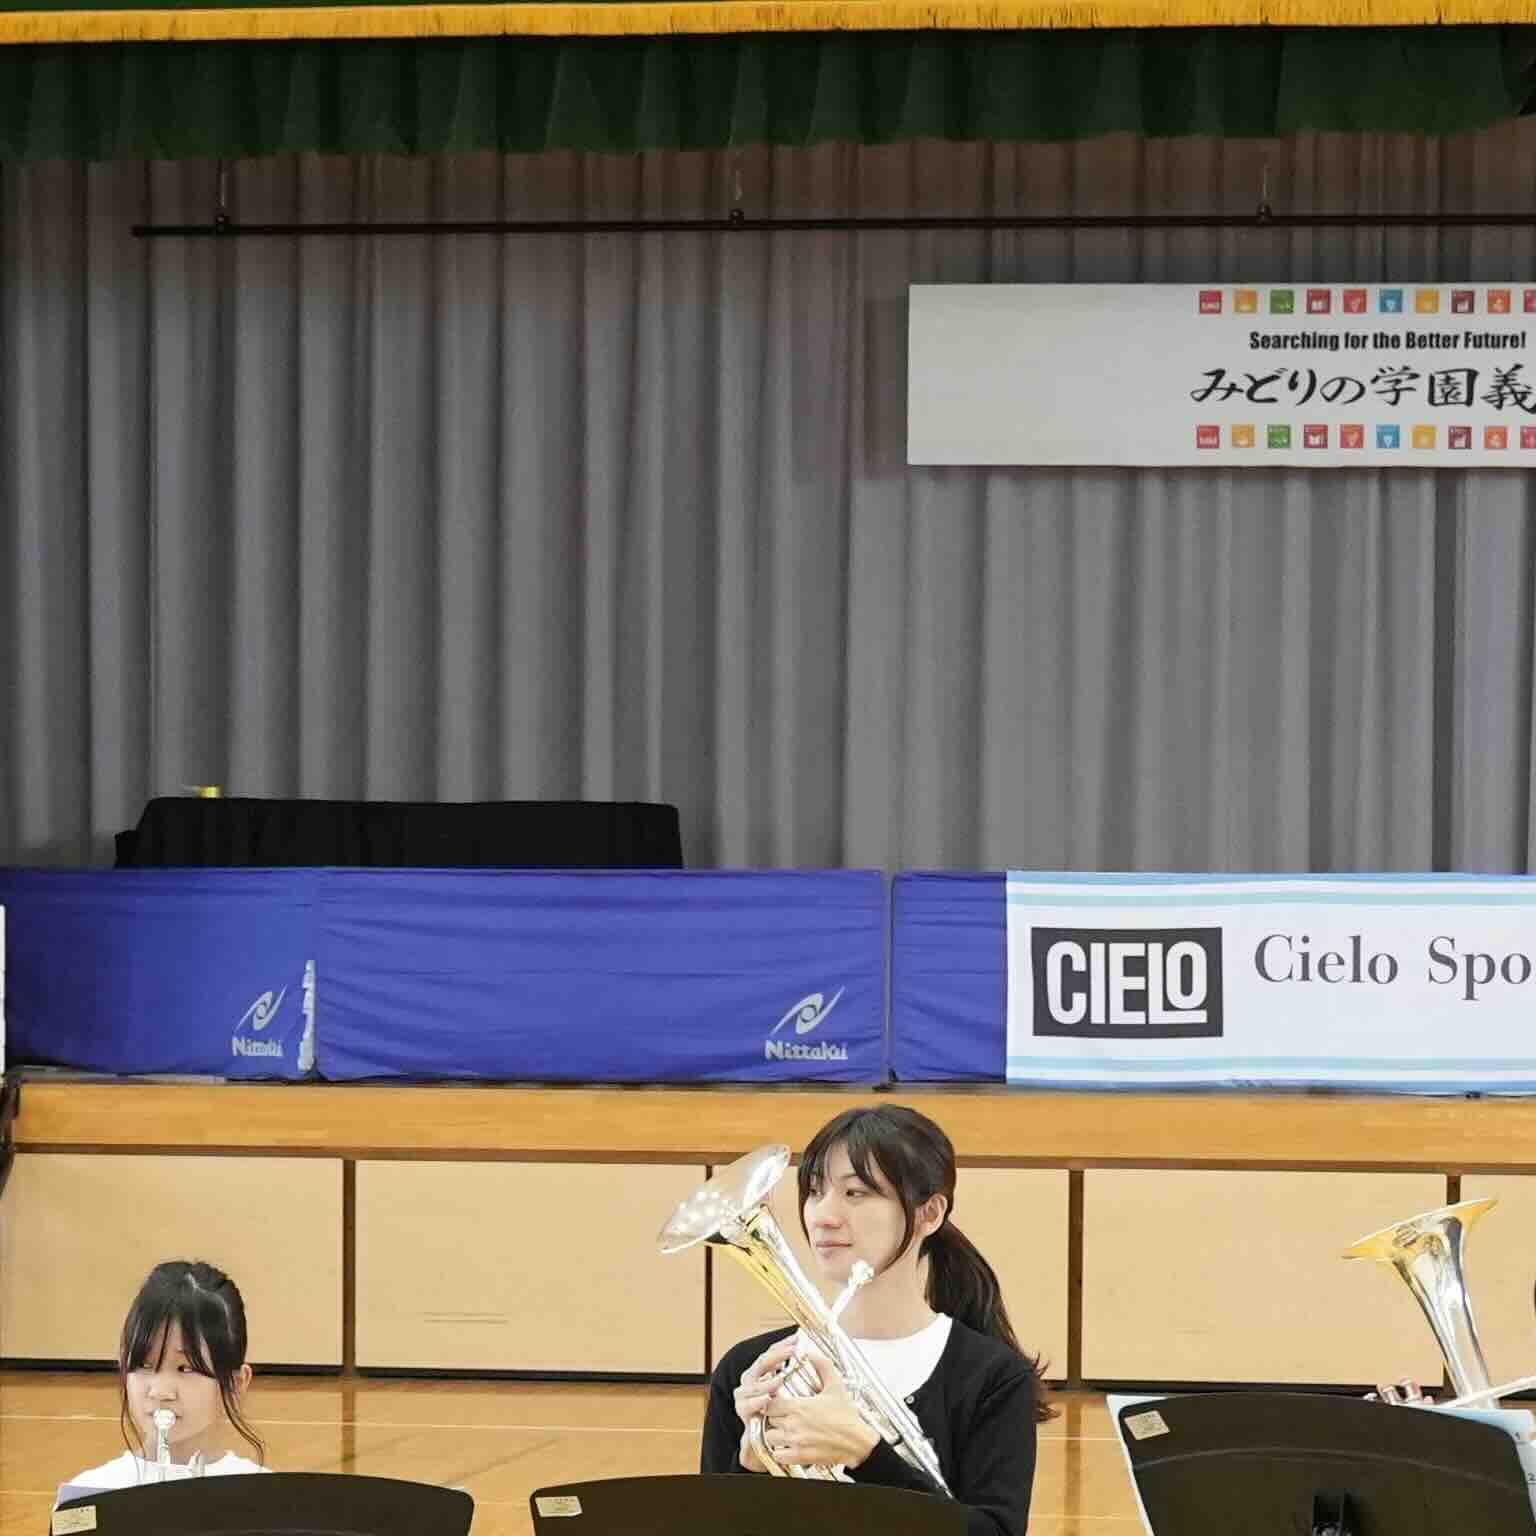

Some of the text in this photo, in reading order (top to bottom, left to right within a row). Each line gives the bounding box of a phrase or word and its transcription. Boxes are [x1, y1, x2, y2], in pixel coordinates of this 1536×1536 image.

[1250, 331, 1527, 351] Searching for the Better Future!
[1253, 933, 1400, 986] Cielo
[1046, 940, 1208, 1025] CIELO
[765, 1040, 848, 1060] Nittaku
